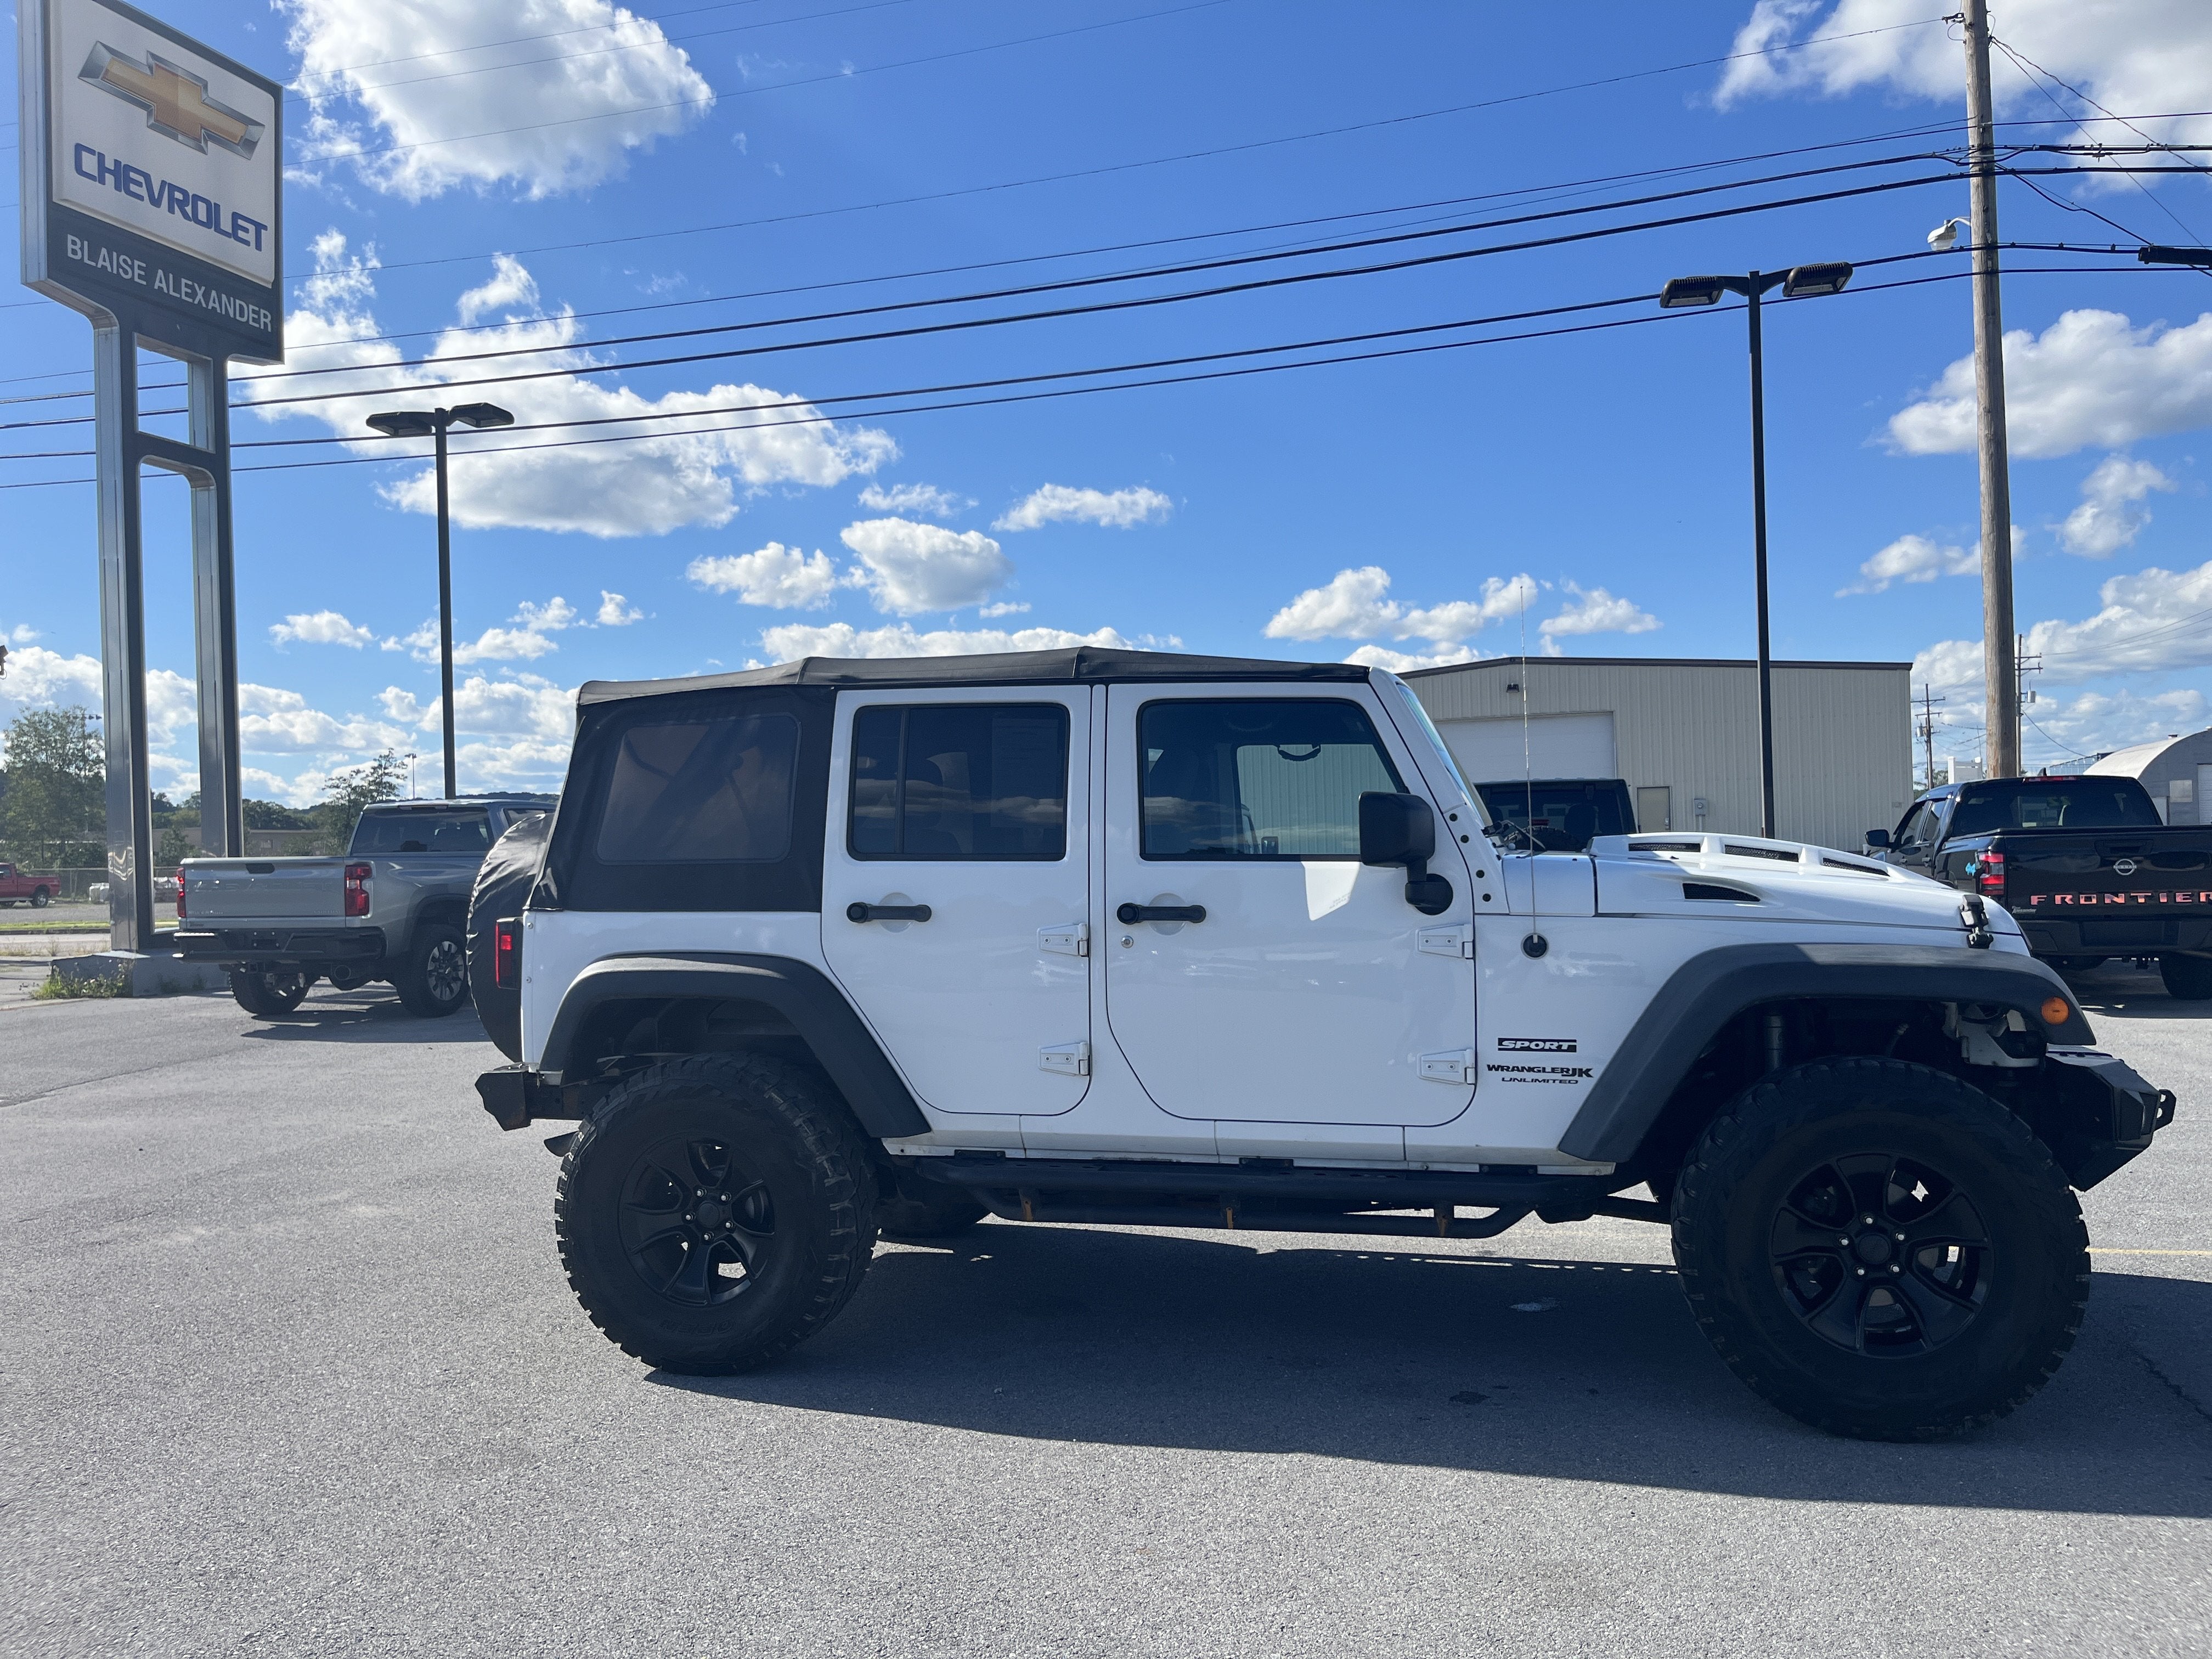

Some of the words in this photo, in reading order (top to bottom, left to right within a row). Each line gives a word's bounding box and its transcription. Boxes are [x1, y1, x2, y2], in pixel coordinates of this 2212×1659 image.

[75, 143, 268, 252] CHEVROLET
[67, 234, 147, 285] BLAISE
[154, 269, 272, 332] ALEXANDER
[2030, 891, 2212, 906] FRONTIER
[1499, 1040, 1575, 1050] SPORT
